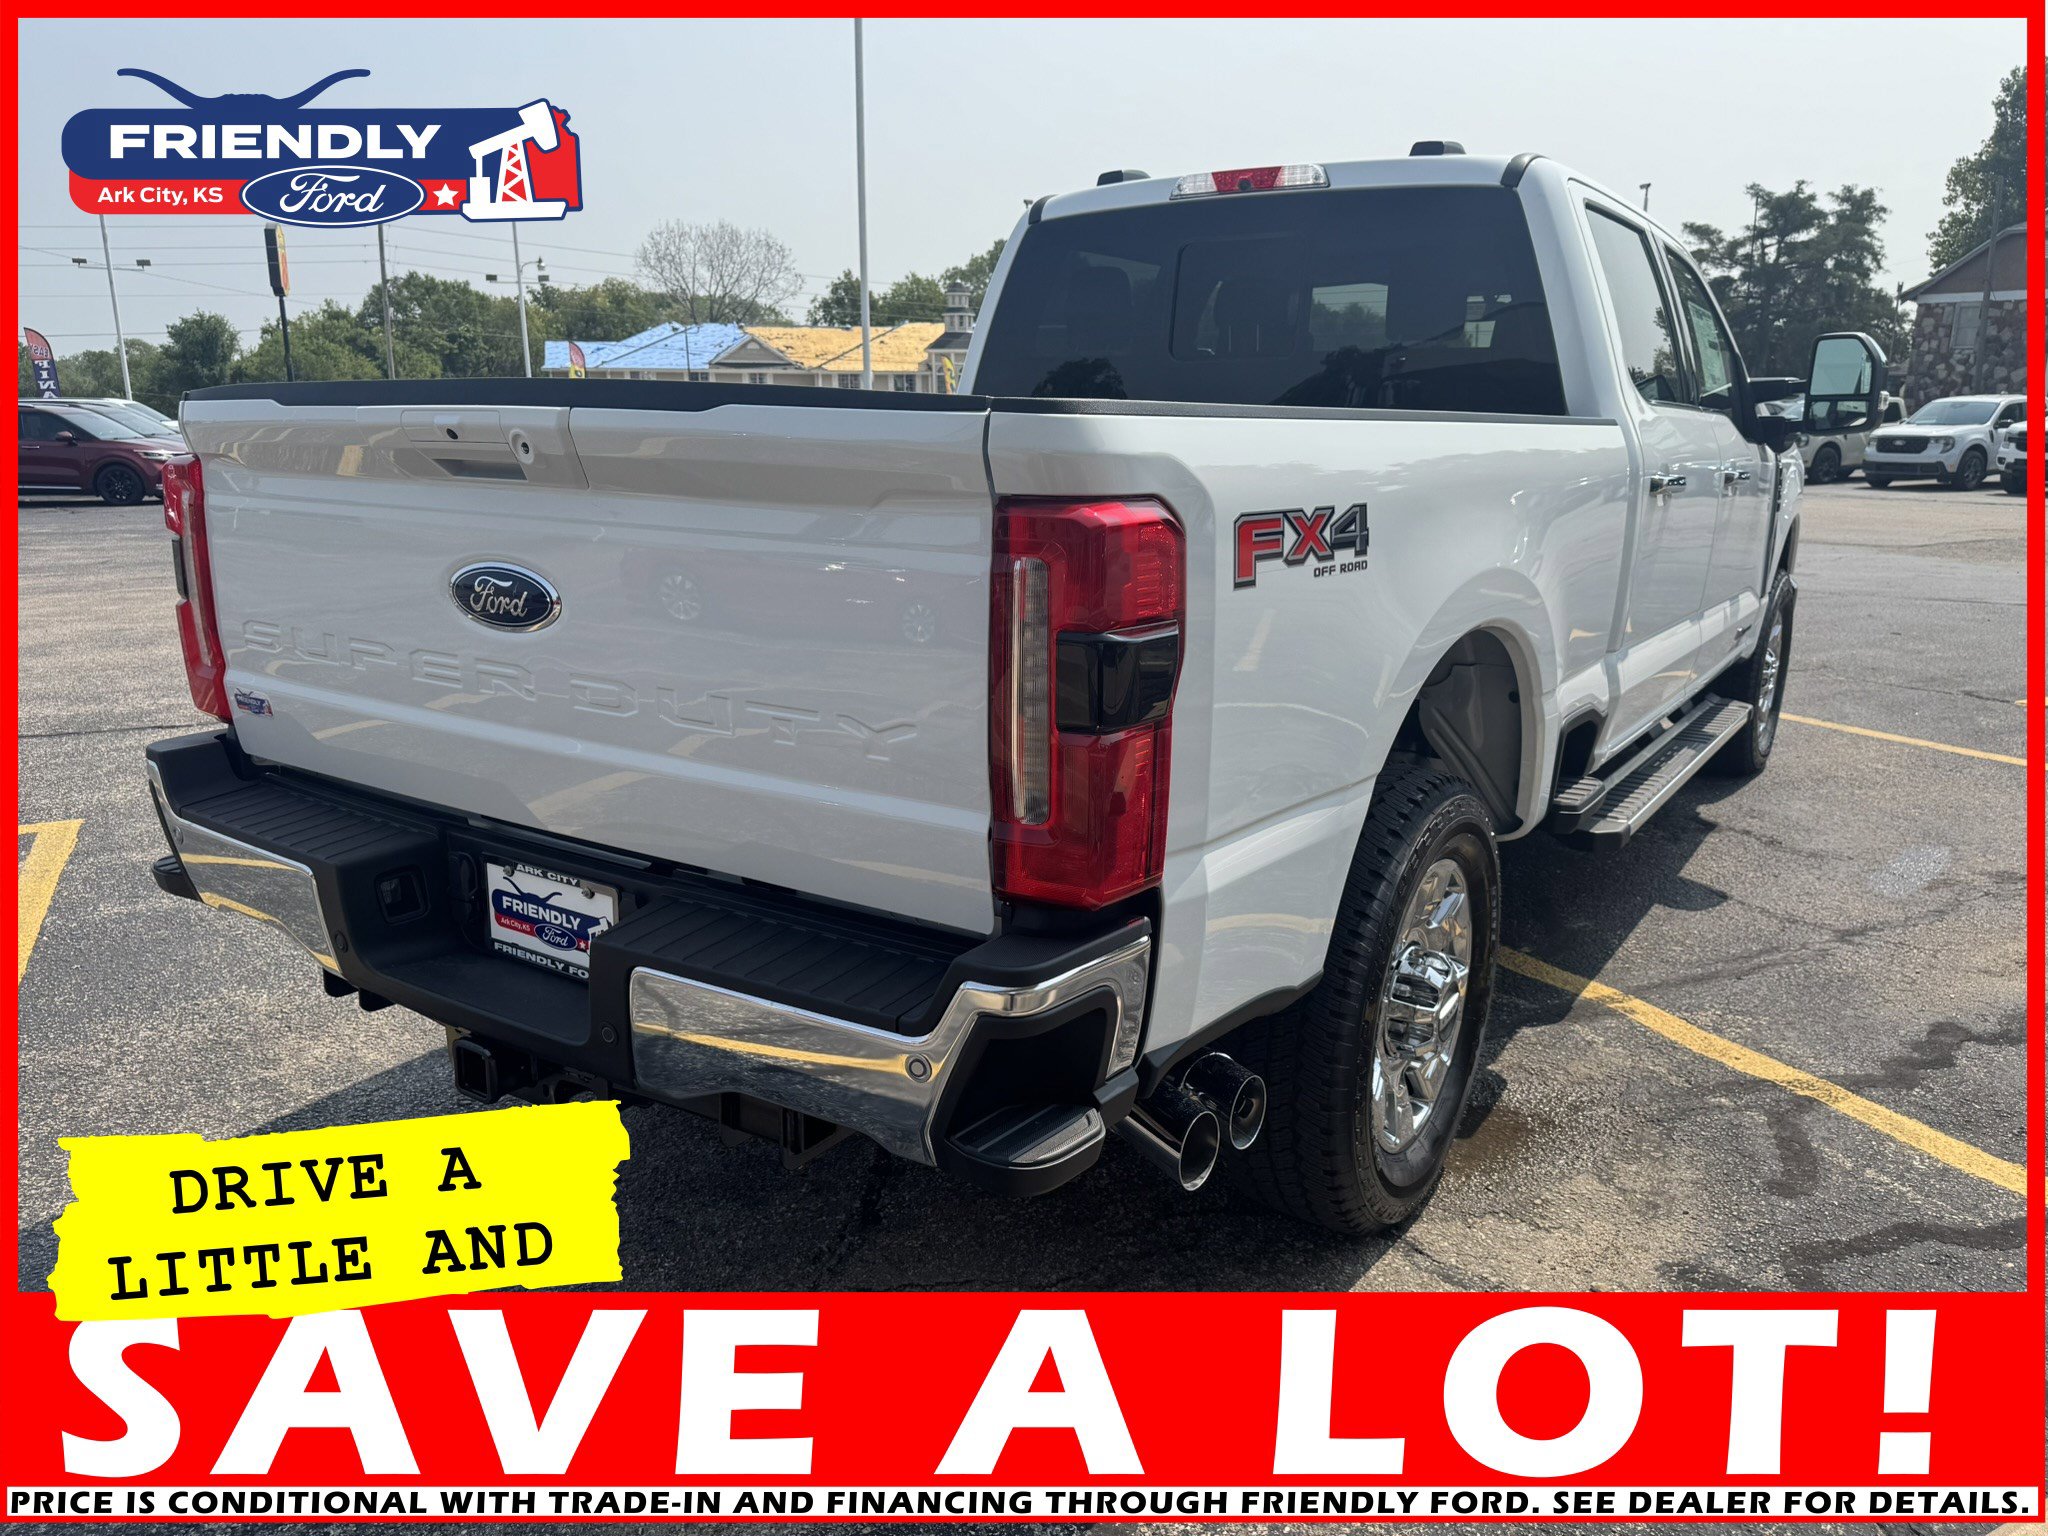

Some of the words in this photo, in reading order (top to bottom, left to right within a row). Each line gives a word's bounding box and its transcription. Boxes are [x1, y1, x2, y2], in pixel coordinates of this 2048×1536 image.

[1233, 502, 1369, 591] FX4
[1313, 565, 1336, 578] OFF
[1339, 560, 1368, 575] ROAD
[469, 575, 528, 618] Ford
[242, 618, 537, 701] SUPER
[569, 672, 918, 761] DUTY
[516, 863, 543, 877] ARK
[547, 872, 579, 886] CITY
[500, 917, 510, 926] Ark
[522, 922, 531, 932] KS
[502, 895, 581, 931] FRIENDLY
[542, 926, 569, 947] Ford
[494, 942, 565, 971] FRIENDLY
